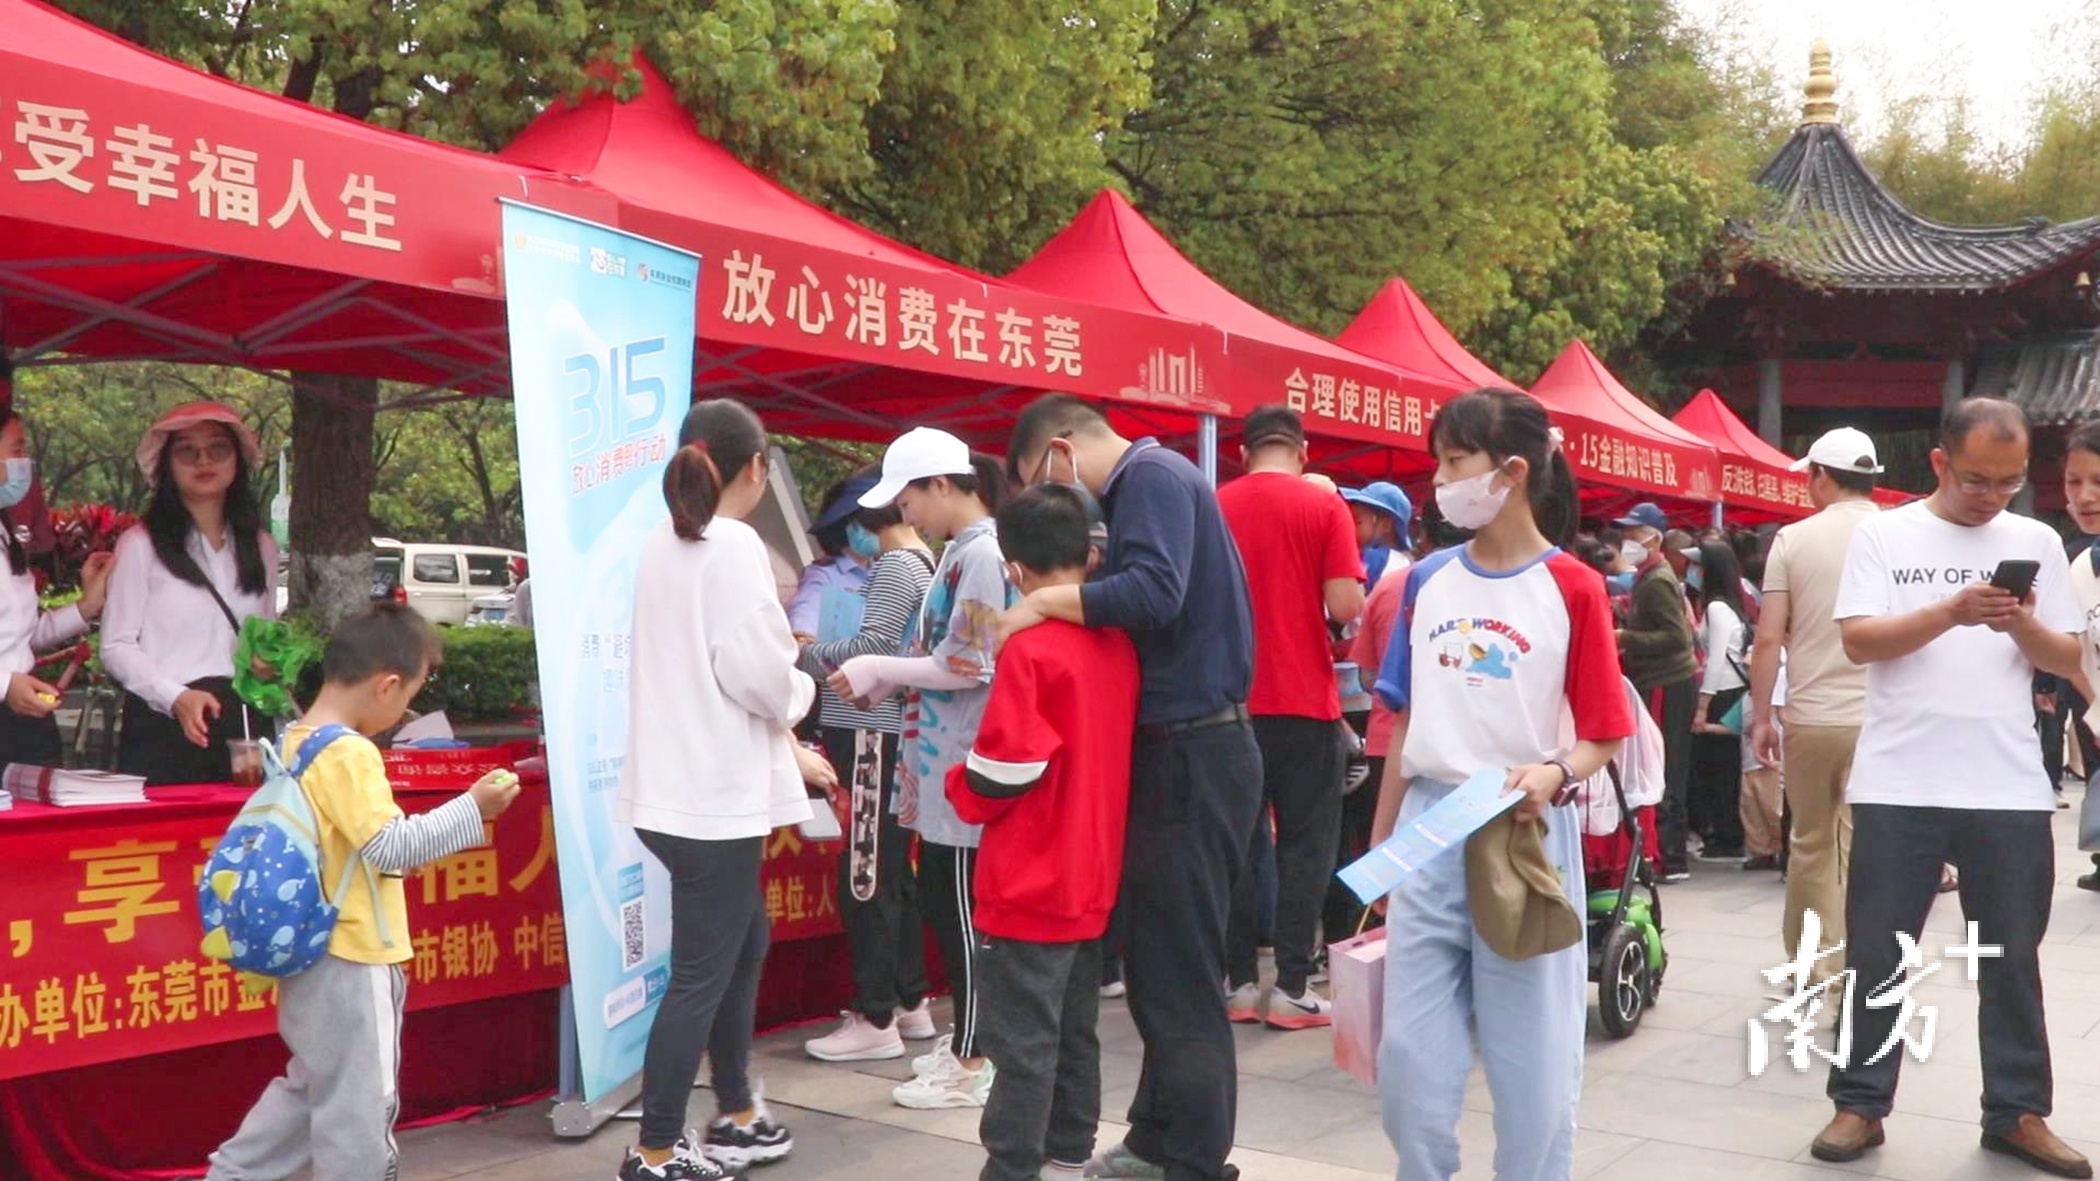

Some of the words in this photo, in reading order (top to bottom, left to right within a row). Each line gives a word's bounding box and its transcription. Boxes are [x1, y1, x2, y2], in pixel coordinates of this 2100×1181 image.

[0, 101, 402, 251] 受幸福人生
[722, 250, 1083, 377] 放心消费在东莞
[564, 334, 667, 459] 315
[1892, 568, 1937, 585] WAY
[1944, 568, 1973, 584] OF
[1429, 618, 1468, 642] HAR
[1472, 617, 1531, 653] WORKING
[405, 920, 498, 984] 市银协
